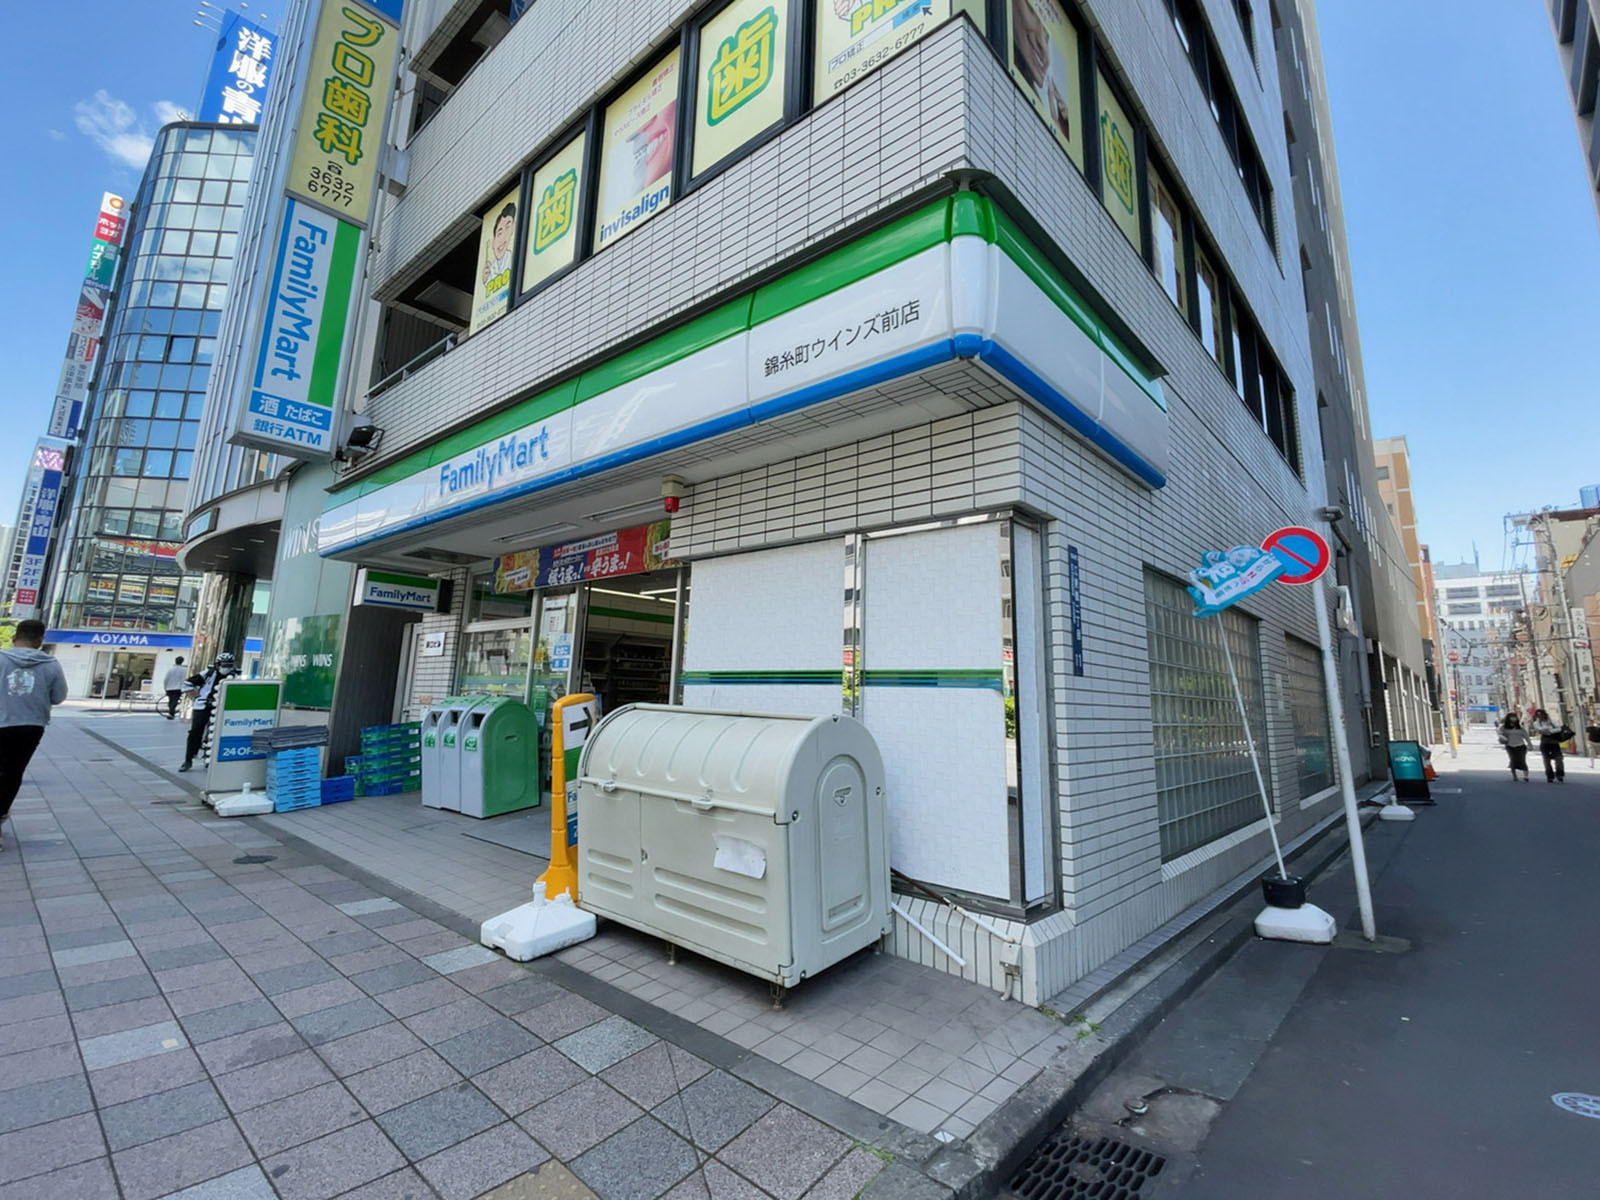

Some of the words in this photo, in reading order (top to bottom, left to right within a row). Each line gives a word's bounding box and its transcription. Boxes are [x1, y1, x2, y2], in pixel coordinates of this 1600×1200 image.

[218, 26, 272, 124] 洋服の青
[314, 7, 385, 165] プロ歯科
[707, 6, 778, 127] 歯
[307, 180, 352, 207] 6777
[310, 166, 354, 196] 3632
[534, 168, 577, 255] 歯
[600, 185, 669, 242] invisalign
[271, 219, 328, 381] FamilyMart
[764, 299, 920, 378] 錦糸町ウインズ前店
[253, 418, 322, 446] 銀行ATM
[258, 395, 280, 416] 酒
[285, 404, 324, 427] たばこ
[440, 426, 548, 496] FamilyMart
[370, 586, 431, 602] FamilyMart
[91, 633, 148, 645] AOYAMA
[312, 653, 332, 667] WINS
[224, 718, 272, 727] FamilyMart
